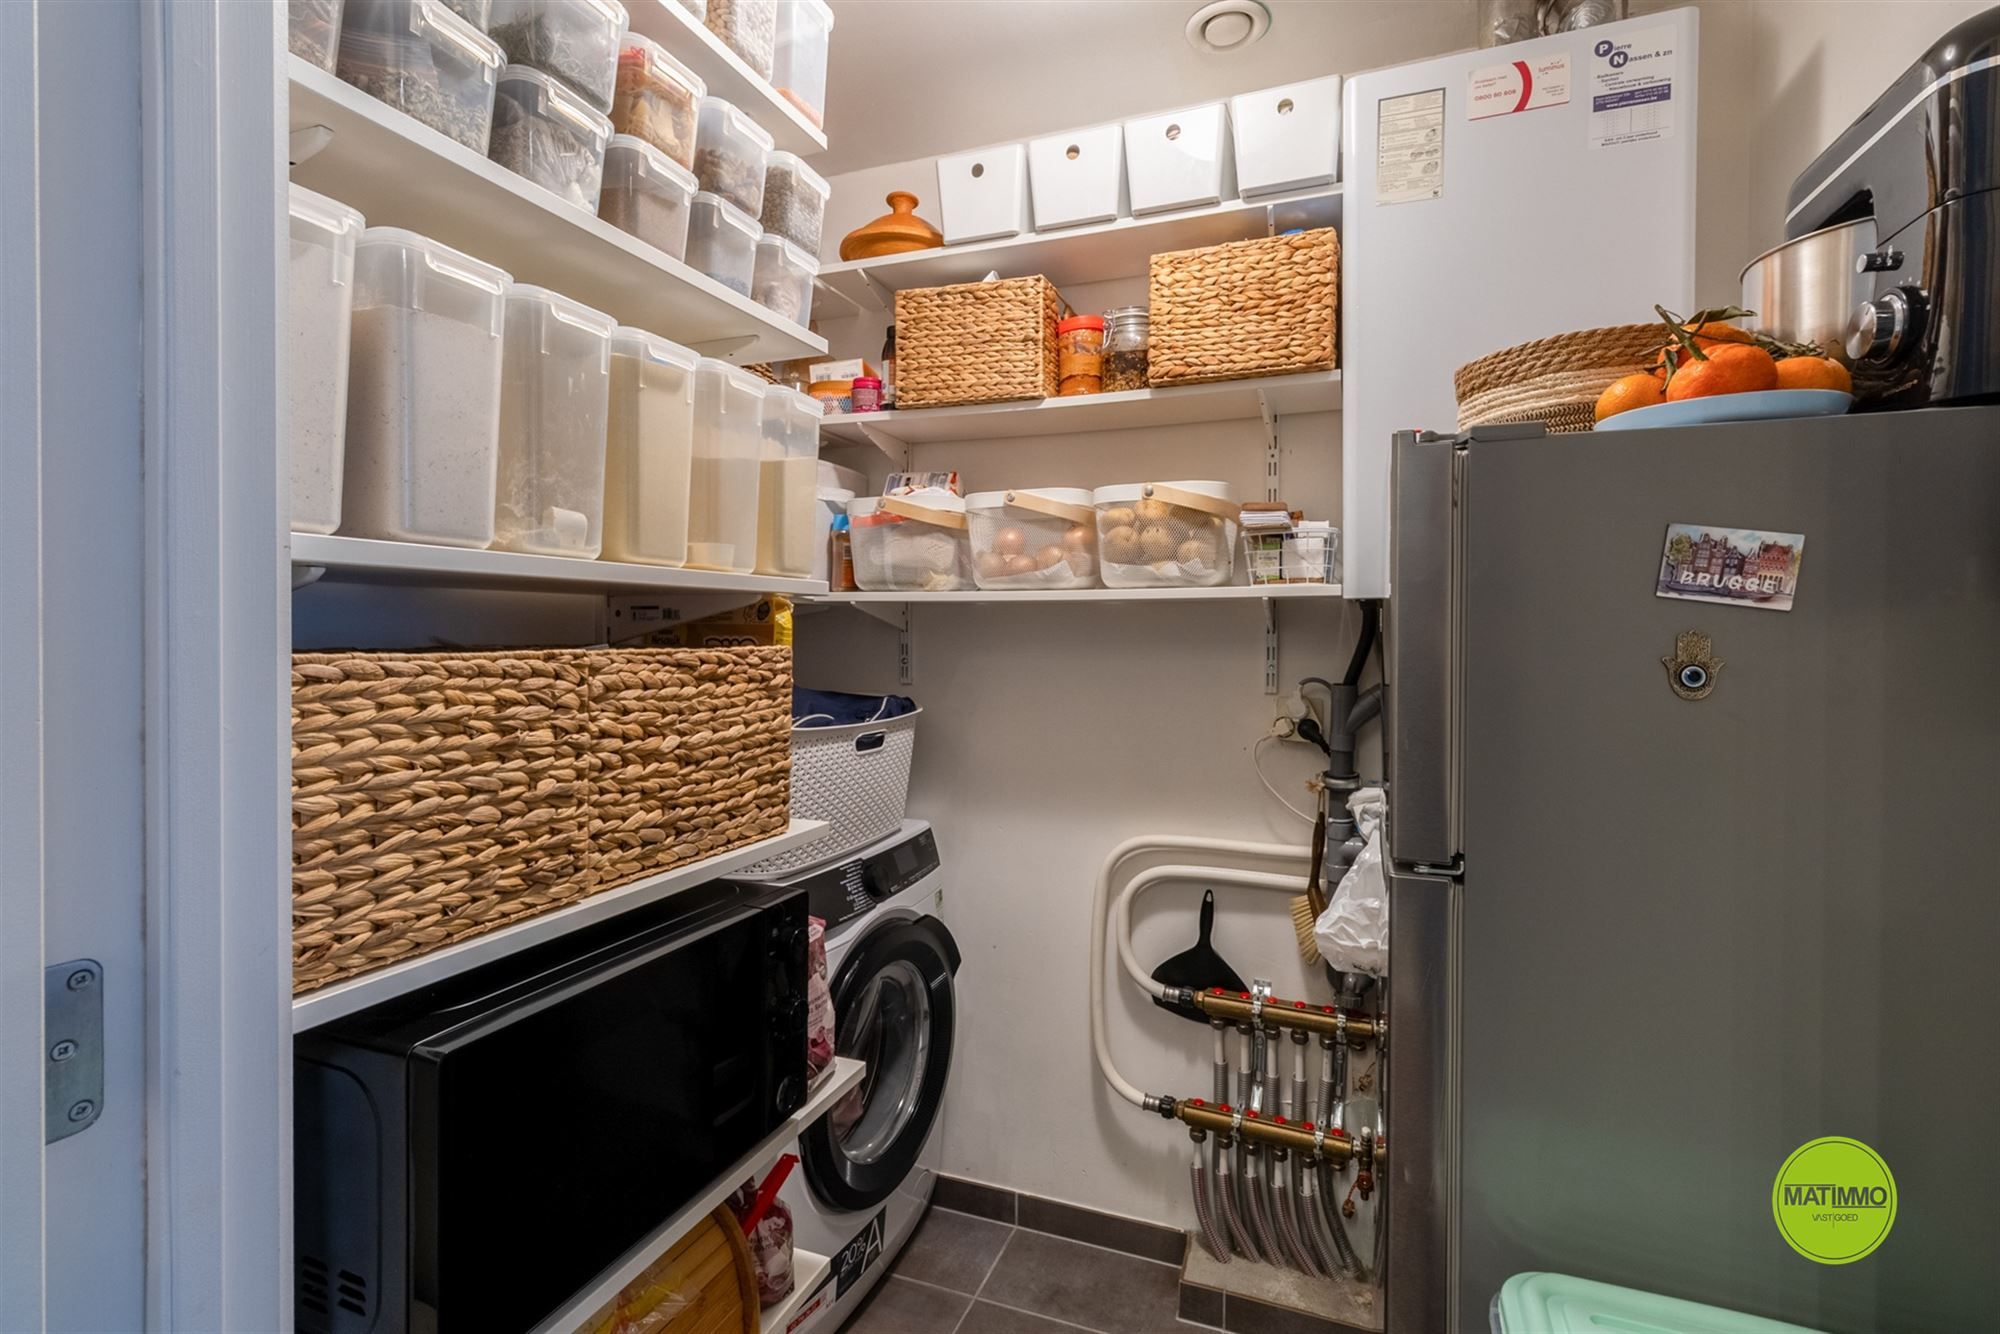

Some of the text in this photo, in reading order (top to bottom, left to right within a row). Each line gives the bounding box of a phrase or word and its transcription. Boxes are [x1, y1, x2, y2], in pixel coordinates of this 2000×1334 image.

[1598, 43, 1632, 55] Pierre
[1612, 53, 1653, 66] Nassen
[1679, 571, 1776, 594] BRUGGE
